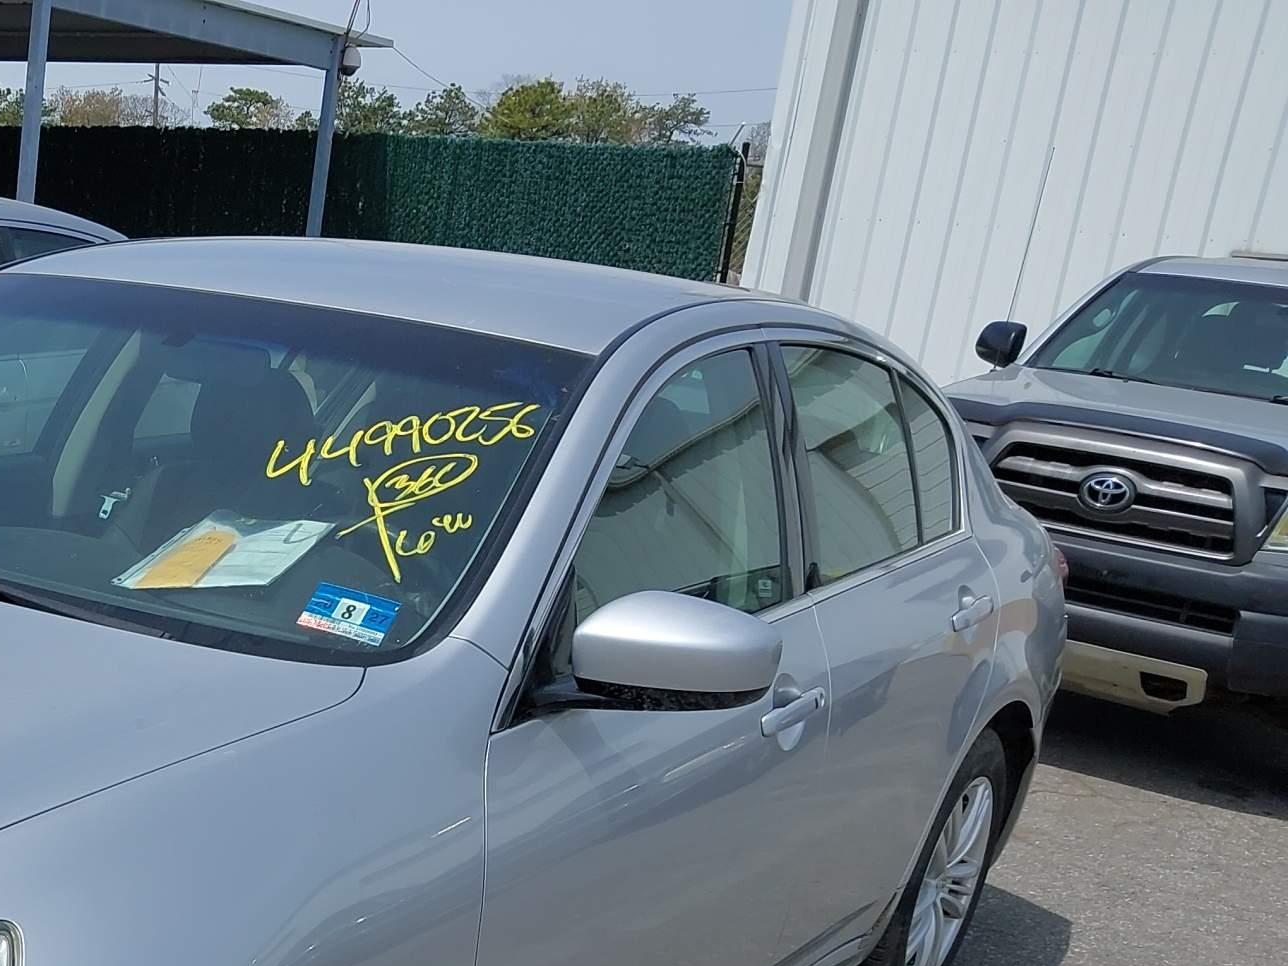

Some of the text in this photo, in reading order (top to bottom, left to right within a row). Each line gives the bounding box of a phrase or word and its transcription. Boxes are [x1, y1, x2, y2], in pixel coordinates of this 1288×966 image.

[265, 402, 541, 486] 44990256
[341, 604, 357, 620] 8
[368, 612, 390, 625] 27
